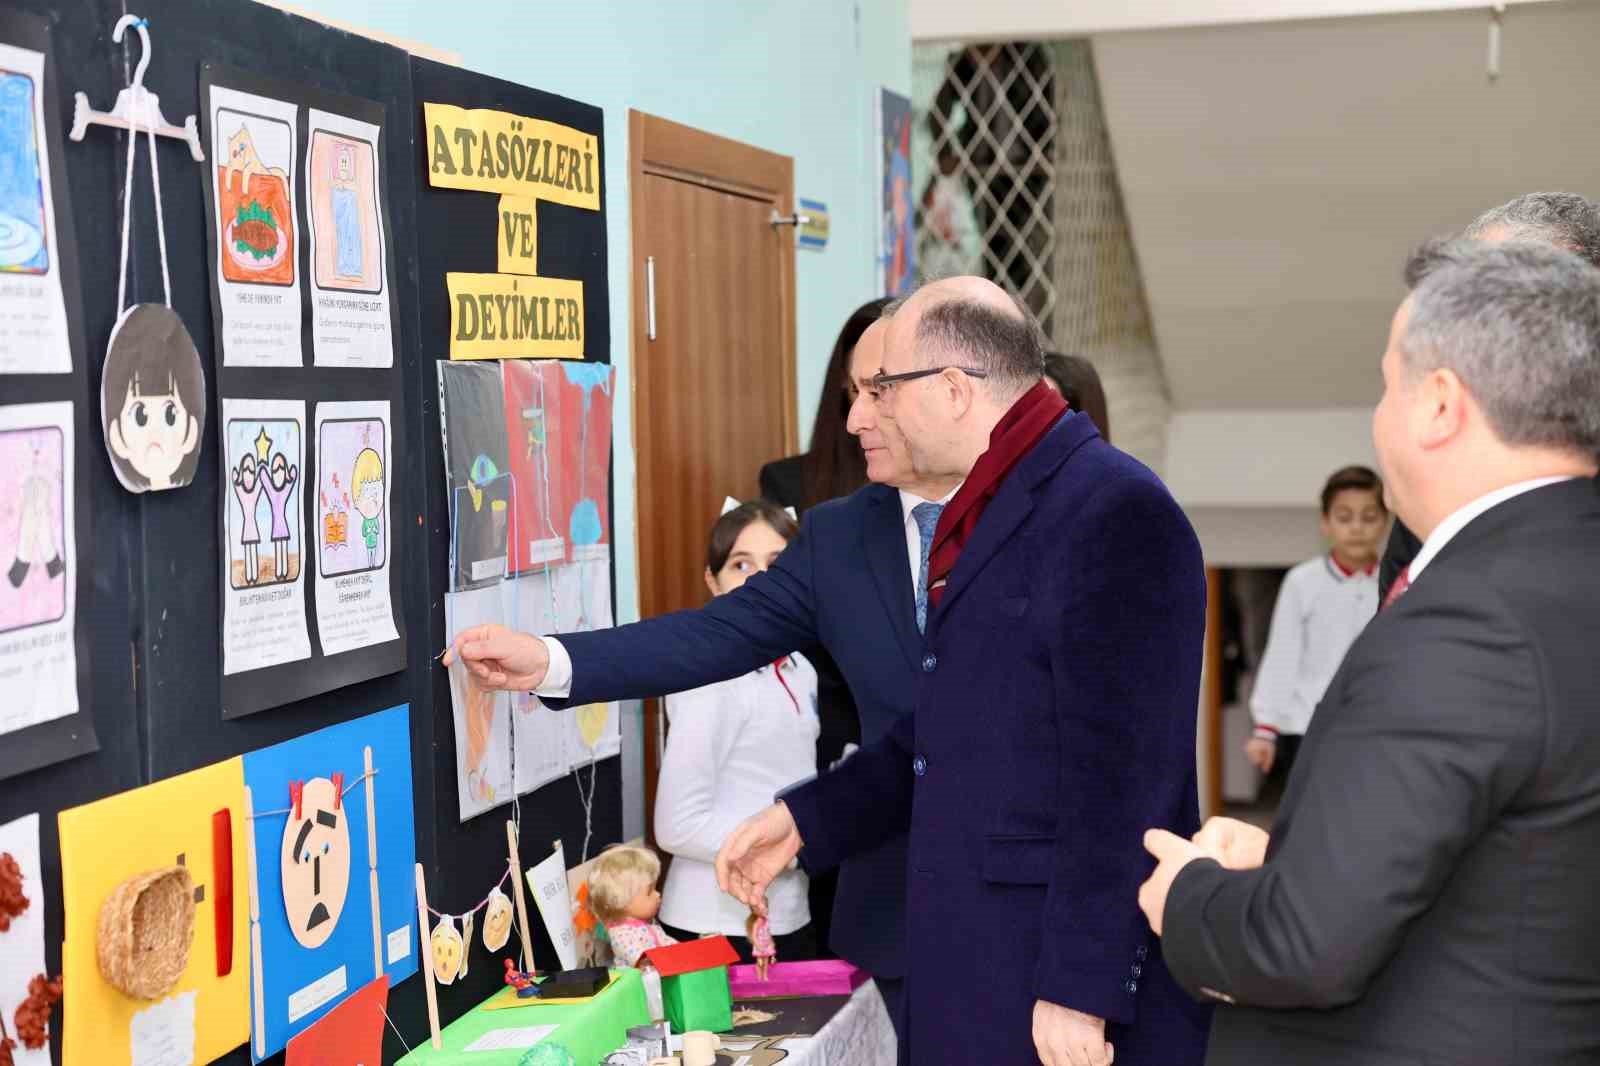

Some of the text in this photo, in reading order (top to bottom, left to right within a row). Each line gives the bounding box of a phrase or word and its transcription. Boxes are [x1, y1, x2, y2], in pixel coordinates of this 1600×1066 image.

[431, 121, 595, 194] ATASÖZLERİ
[503, 211, 534, 258] VE
[456, 280, 581, 341] DEYİMLER
